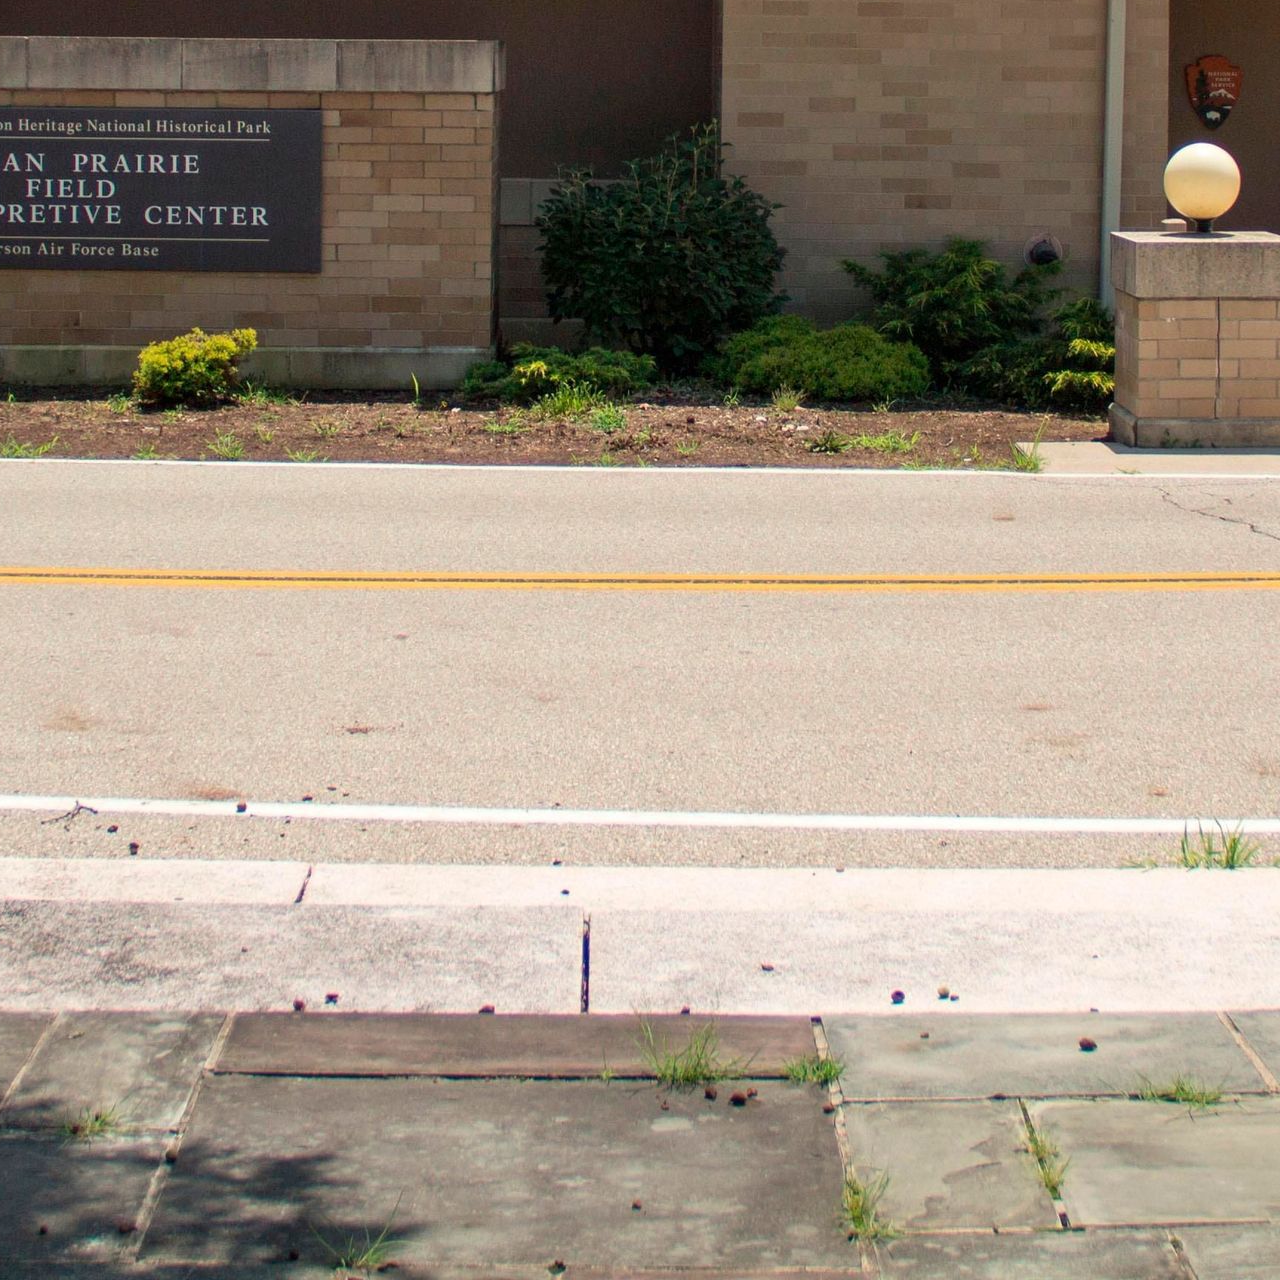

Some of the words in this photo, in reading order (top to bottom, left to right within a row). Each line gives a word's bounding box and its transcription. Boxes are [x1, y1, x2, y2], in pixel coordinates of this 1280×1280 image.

[18, 118, 82, 135] Heritage
[87, 119, 151, 133] National
[156, 120, 232, 134] Historical
[237, 120, 271, 134] Park
[73, 153, 200, 174] PRAIRIE
[26, 178, 116, 199] FIELD
[144, 205, 269, 226] CENTER
[37, 242, 64, 255] Air
[71, 242, 115, 256] Force
[122, 243, 160, 256] Base
